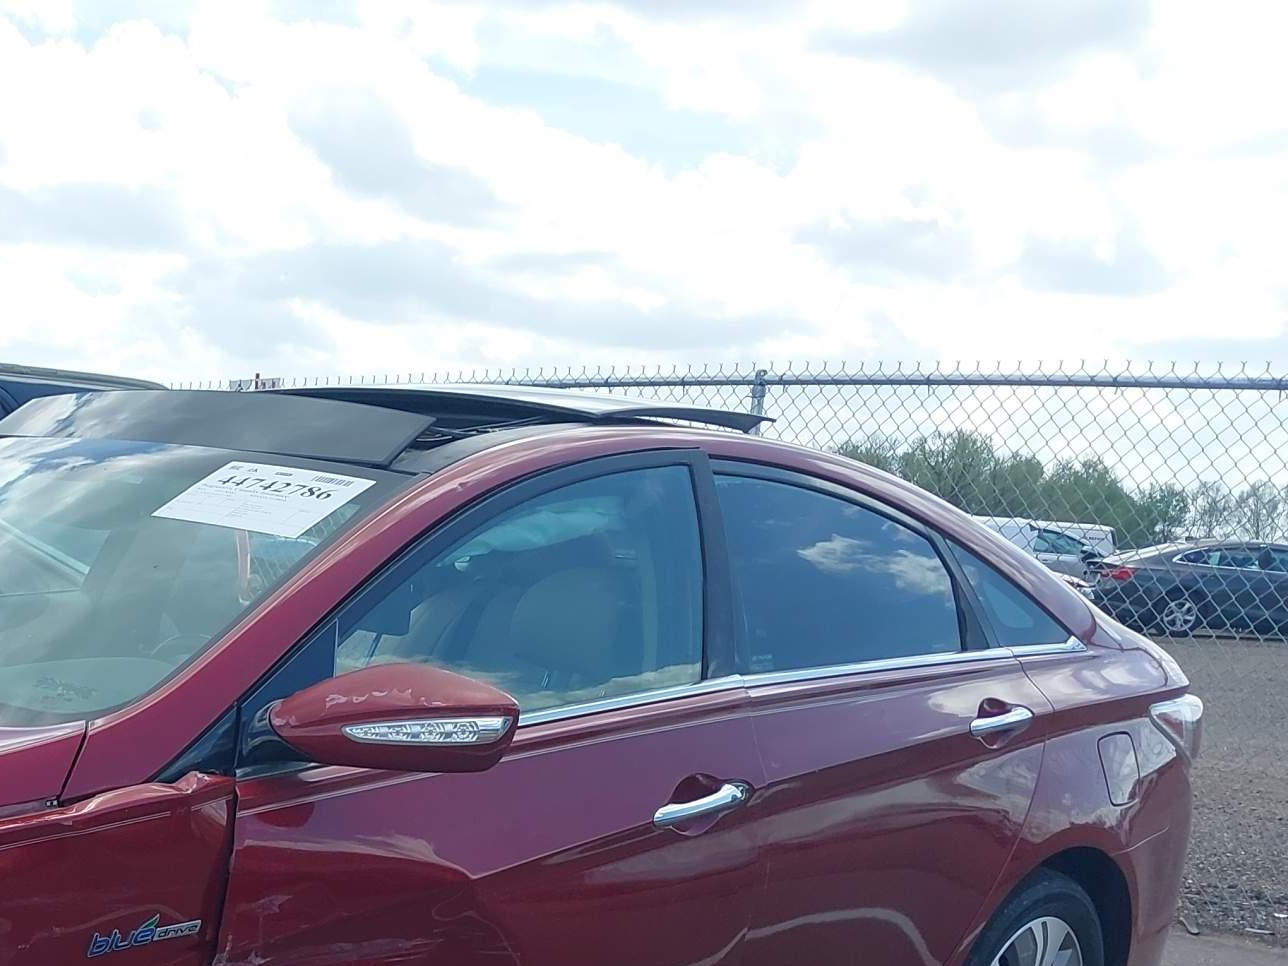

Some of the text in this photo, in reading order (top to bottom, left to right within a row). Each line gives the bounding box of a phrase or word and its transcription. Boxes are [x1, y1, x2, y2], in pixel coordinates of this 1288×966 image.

[218, 475, 336, 500] 44742786
[88, 923, 199, 957] blue drive
